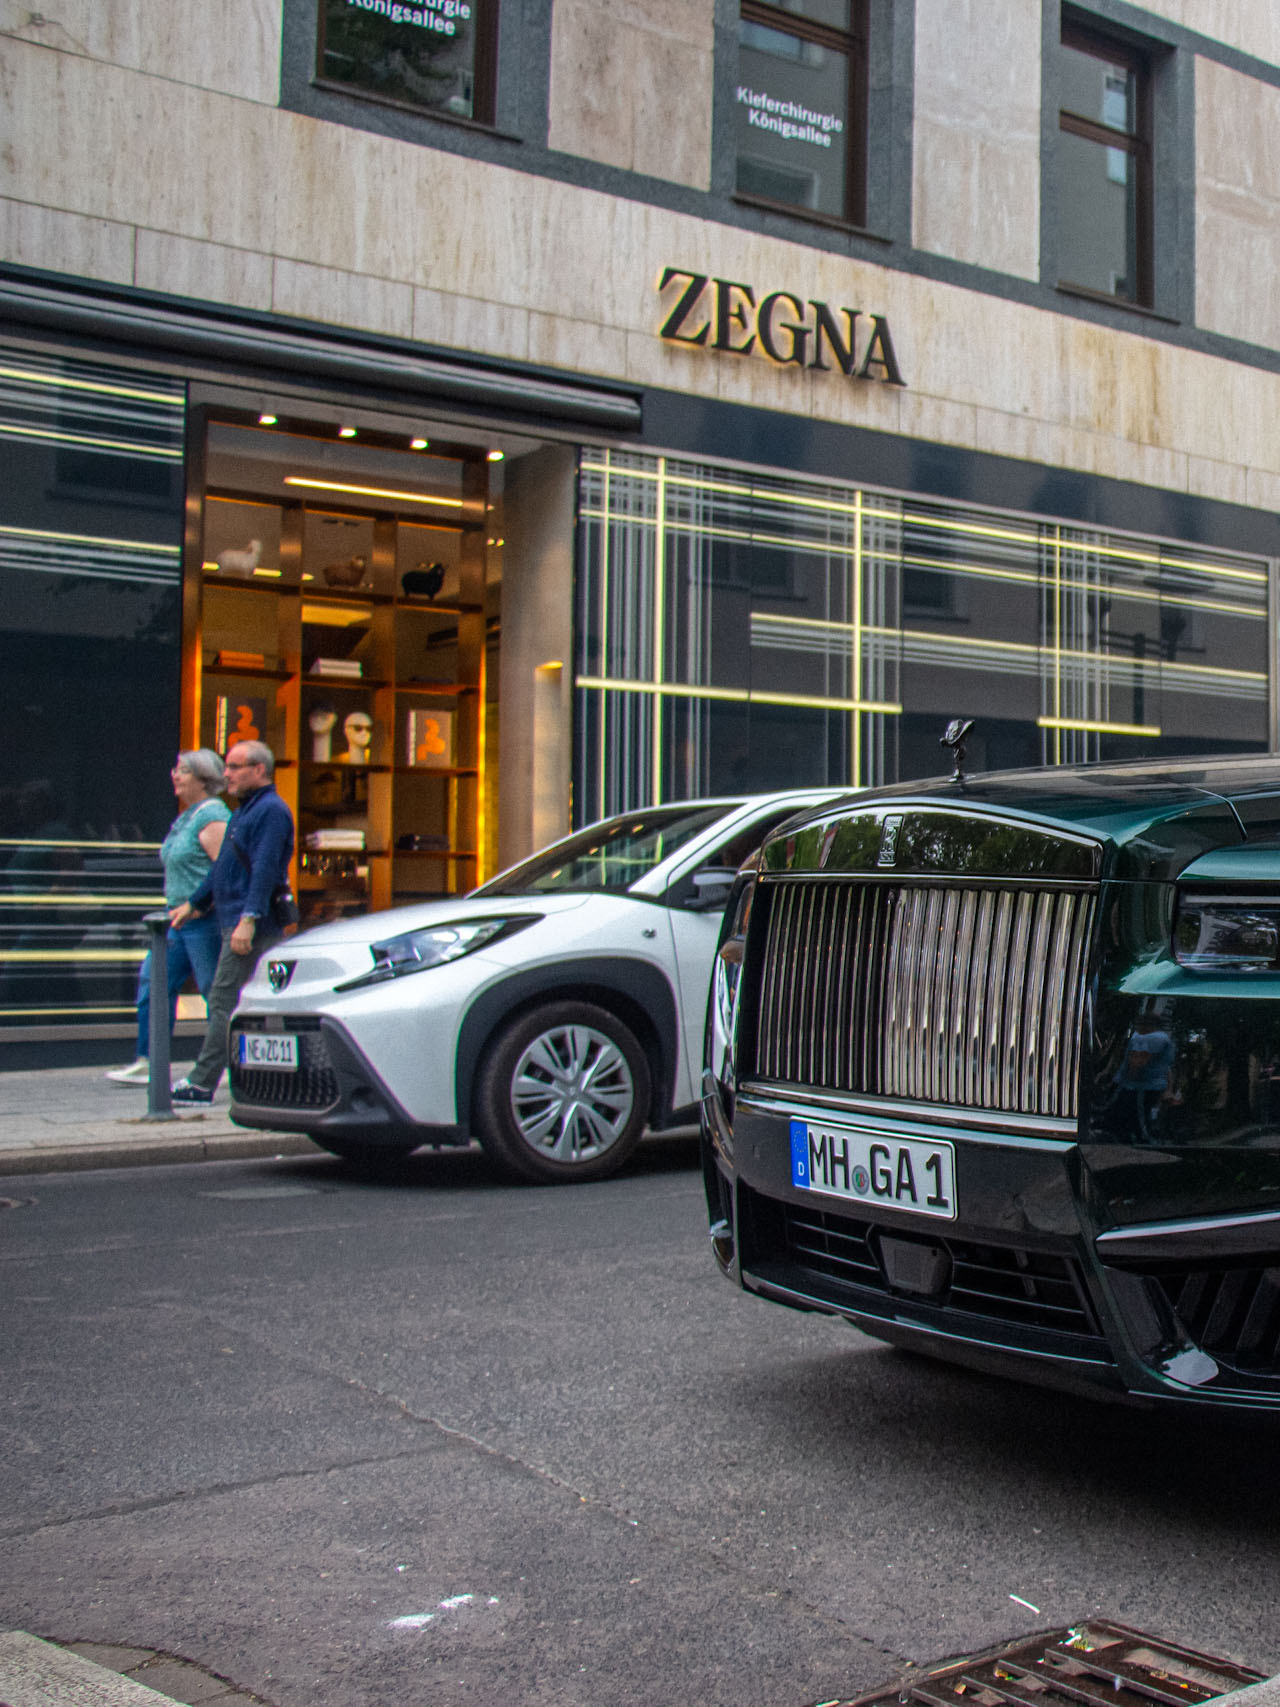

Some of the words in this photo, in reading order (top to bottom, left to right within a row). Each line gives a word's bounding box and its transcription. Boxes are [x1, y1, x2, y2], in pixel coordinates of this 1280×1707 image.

[737, 86, 843, 132] Kieferchirurgie
[748, 108, 831, 147] Königsallee
[658, 266, 907, 386] ZEGNA
[797, 1161, 805, 1176] D
[808, 1129, 850, 1190] MH
[870, 1143, 917, 1203] GA
[925, 1151, 949, 1209] 1
